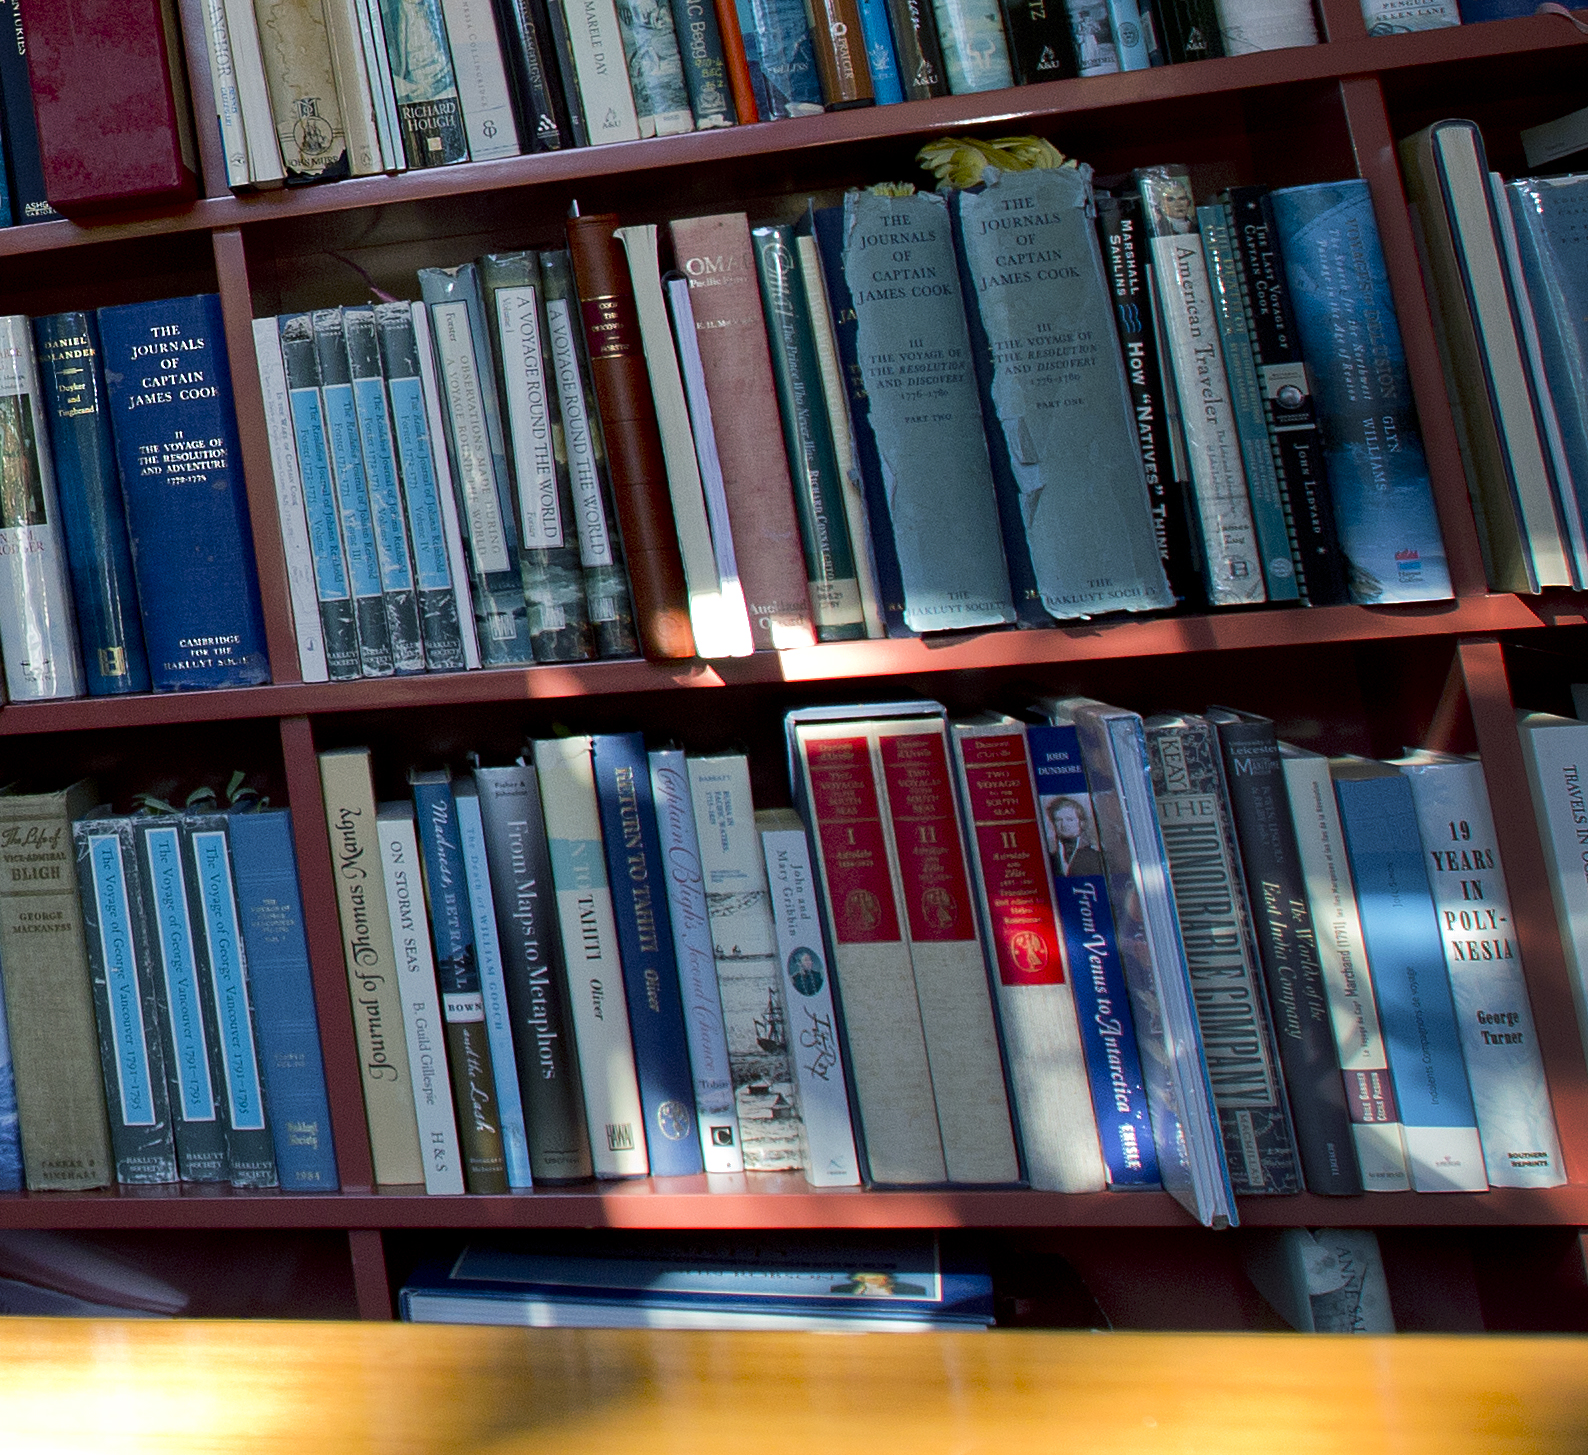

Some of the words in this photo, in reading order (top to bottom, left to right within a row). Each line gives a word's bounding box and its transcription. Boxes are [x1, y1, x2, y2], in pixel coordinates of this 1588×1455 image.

[584, 1, 603, 48] MARELE
[594, 52, 608, 76] DAY
[686, 22, 708, 59] Begg
[1109, 235, 1126, 296] SAHLINS
[1120, 220, 1139, 295] MARSHALL
[1175, 246, 1206, 338] American
[131, 339, 204, 360] JOURNALS
[150, 326, 180, 337] THE
[142, 372, 204, 388] CAPTAIN
[160, 357, 179, 369] OF
[1189, 343, 1222, 426] Traveler
[128, 394, 173, 410] JAMES
[178, 387, 220, 400] COOK
[1160, 738, 1185, 787] KEAY
[614, 767, 642, 850] RETURN
[1448, 821, 1472, 841] 19
[506, 821, 529, 874] From
[629, 853, 646, 881] TO
[1431, 851, 1497, 871] YEARS
[511, 878, 538, 936] Maps
[1073, 883, 1101, 932] From
[1160, 821, 1245, 979] HONOURABLE
[1459, 880, 1486, 900] IN
[351, 885, 379, 971] Thomas
[633, 887, 658, 953] TAHITI
[525, 940, 541, 962] to
[1083, 934, 1113, 993] Venus
[1452, 941, 1516, 961] NESIA
[360, 975, 386, 993] of
[643, 969, 662, 1014] Oliver
[1094, 997, 1113, 1015] to
[367, 997, 398, 1082] Journal
[524, 965, 559, 1080] Metaphors
[1476, 1011, 1520, 1025] George
[1480, 1031, 1523, 1044] Turner
[1095, 1014, 1133, 1113] Antarctica
[1195, 986, 1270, 1104] COMPANY
